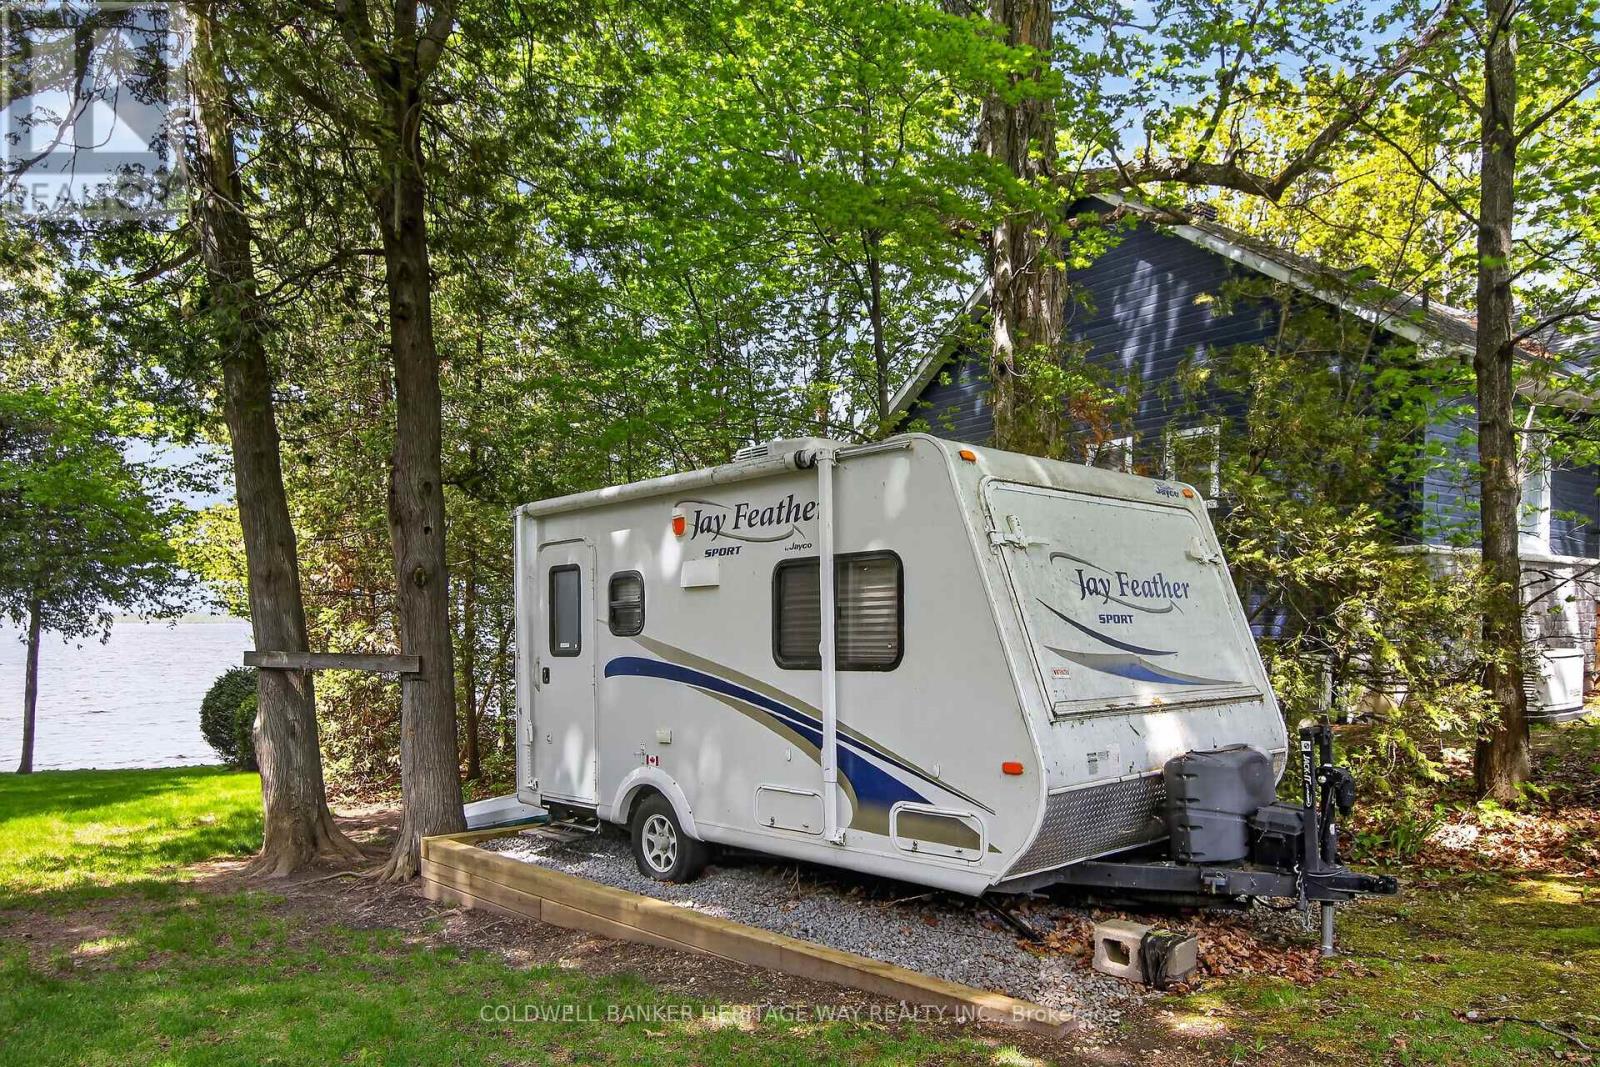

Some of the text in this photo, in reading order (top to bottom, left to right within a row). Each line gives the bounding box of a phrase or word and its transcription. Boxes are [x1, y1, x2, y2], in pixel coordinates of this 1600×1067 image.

[690, 509, 726, 542] Jay
[704, 546, 742, 558] SPORT
[789, 542, 813, 551] Jayco
[1075, 569, 1190, 605] Jay Feather
[1098, 614, 1134, 624] SPORT
